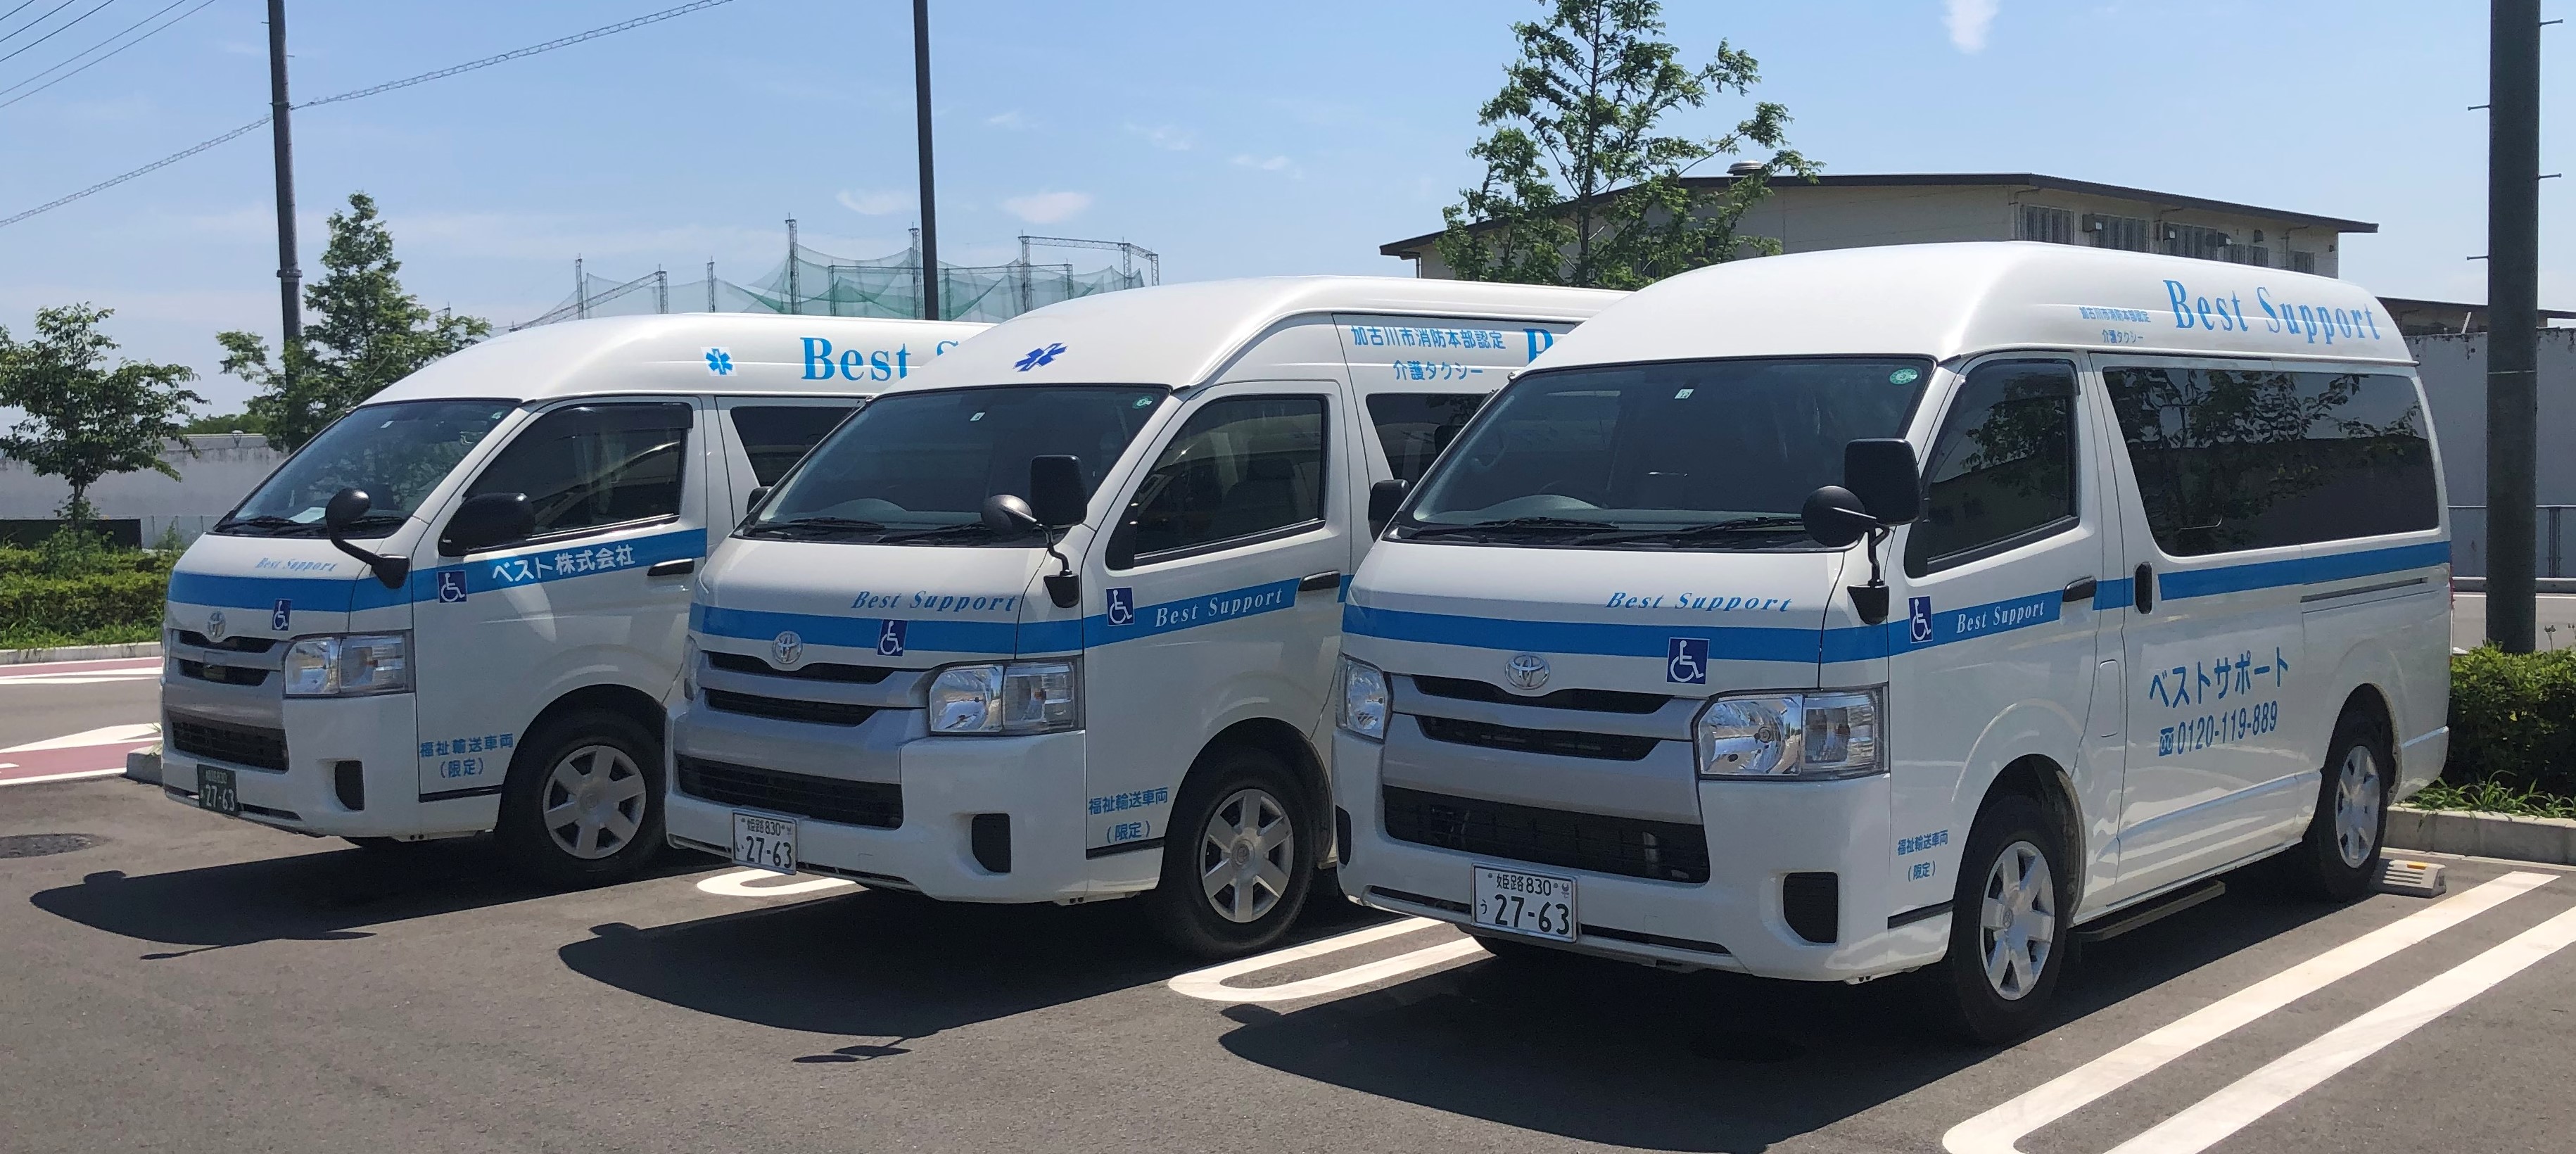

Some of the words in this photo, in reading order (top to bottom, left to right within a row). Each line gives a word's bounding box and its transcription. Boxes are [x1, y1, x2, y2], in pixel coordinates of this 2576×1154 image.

[2162, 279, 2249, 332] Best
[2257, 286, 2380, 345] Support
[1351, 325, 1506, 349] 加古川市消防本部認定
[800, 337, 911, 381] Best
[1393, 360, 1483, 381] 介護タクシー
[283, 559, 338, 571] Support
[493, 544, 635, 582] ベスト株式会社
[851, 590, 901, 609] Best
[910, 590, 1017, 612] Support
[1155, 604, 1198, 627] Best
[1208, 588, 1282, 616] Support
[1606, 592, 1665, 609] Best
[1675, 592, 1793, 612] Support
[1956, 611, 1986, 634] Best
[1993, 600, 2045, 626] Support
[2150, 647, 2288, 708] ベストサポート
[2177, 700, 2278, 755] 0120-119-889
[420, 733, 513, 758] 福祉輸送車両
[1089, 787, 1168, 815] 福祉輸送車両
[1106, 820, 1150, 843] （限定）
[746, 836, 792, 868] 27-63
[1480, 899, 1487, 914] う
[1495, 894, 1570, 934] 27-63
